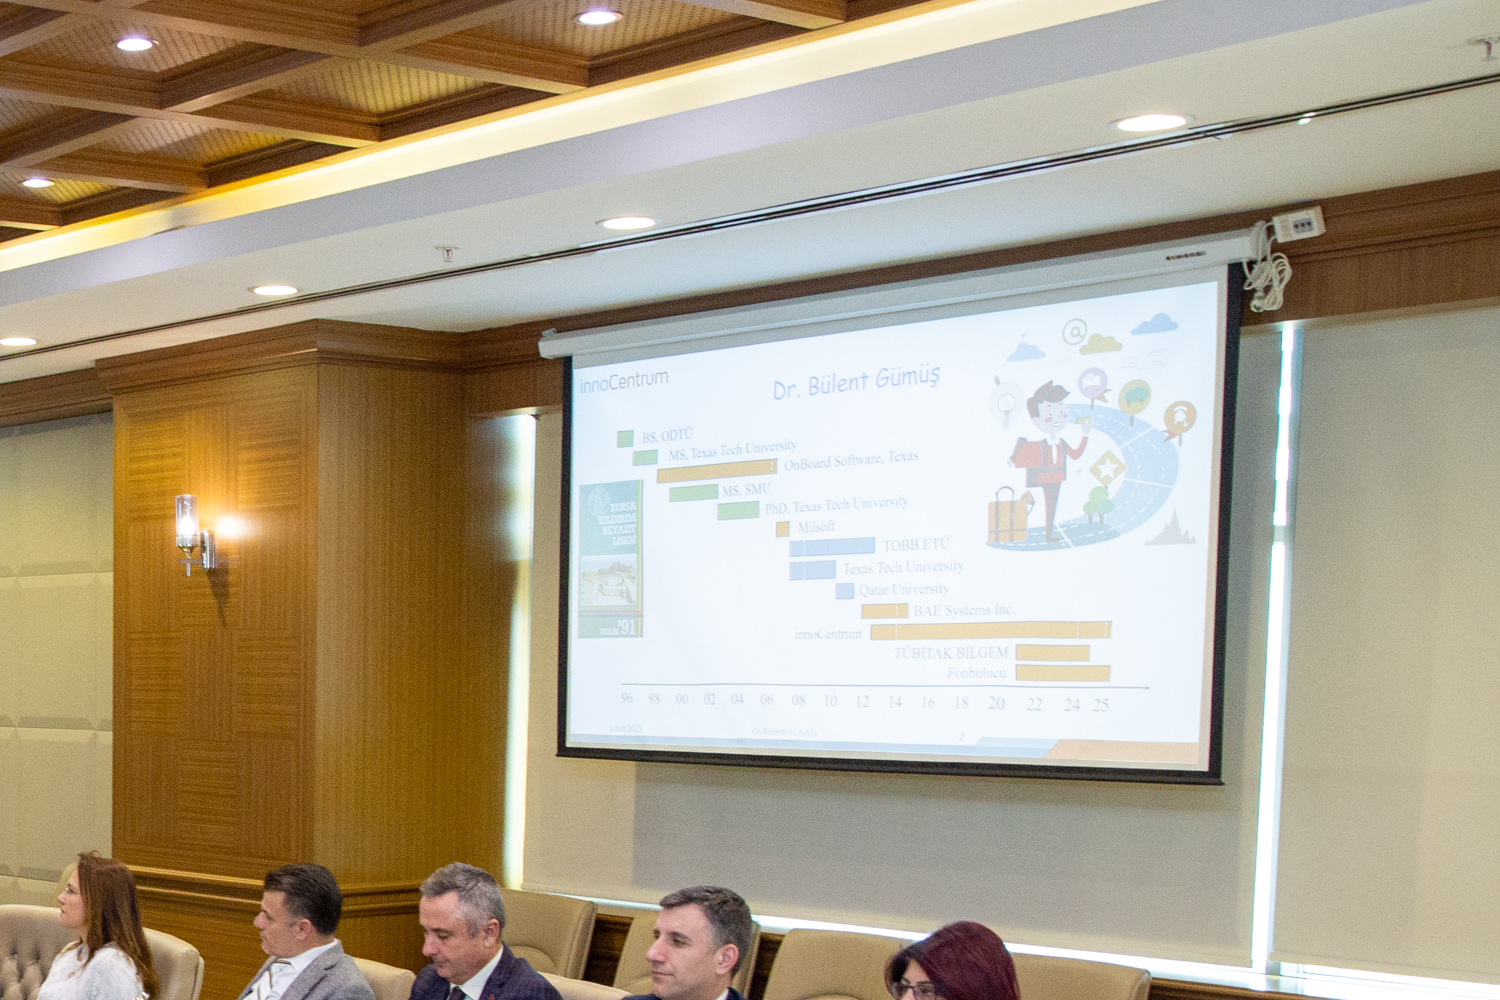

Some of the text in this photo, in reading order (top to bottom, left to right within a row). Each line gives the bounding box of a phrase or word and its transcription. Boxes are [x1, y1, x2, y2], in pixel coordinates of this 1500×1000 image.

[579, 370, 669, 394] innoCentrum
[773, 363, 941, 400] Dr. Bülent Gümüş
[662, 426, 693, 442] ODTÜ
[668, 438, 798, 462] MS, Texas Tech University
[784, 449, 919, 472] OnBoard Software, Texas
[722, 482, 771, 498] MS, SMU
[609, 501, 636, 513] BURSA
[765, 494, 909, 517] PhD, Texas Tech University
[798, 519, 836, 533] Milsoft
[883, 535, 950, 553] TOBB ETÜ
[843, 558, 964, 576] Texas Tech University
[859, 582, 950, 598] Qatar University
[914, 603, 1015, 619] BAE Systems Inc.
[794, 627, 862, 640] innoCentrum
[894, 643, 1009, 660] TÜBİTAK BİLGEM
[948, 666, 1007, 679] Fonbulucu
[621, 692, 1109, 712] 96 98 00 02 04 06 08 10 12 14 16 18 20 22 24 25
